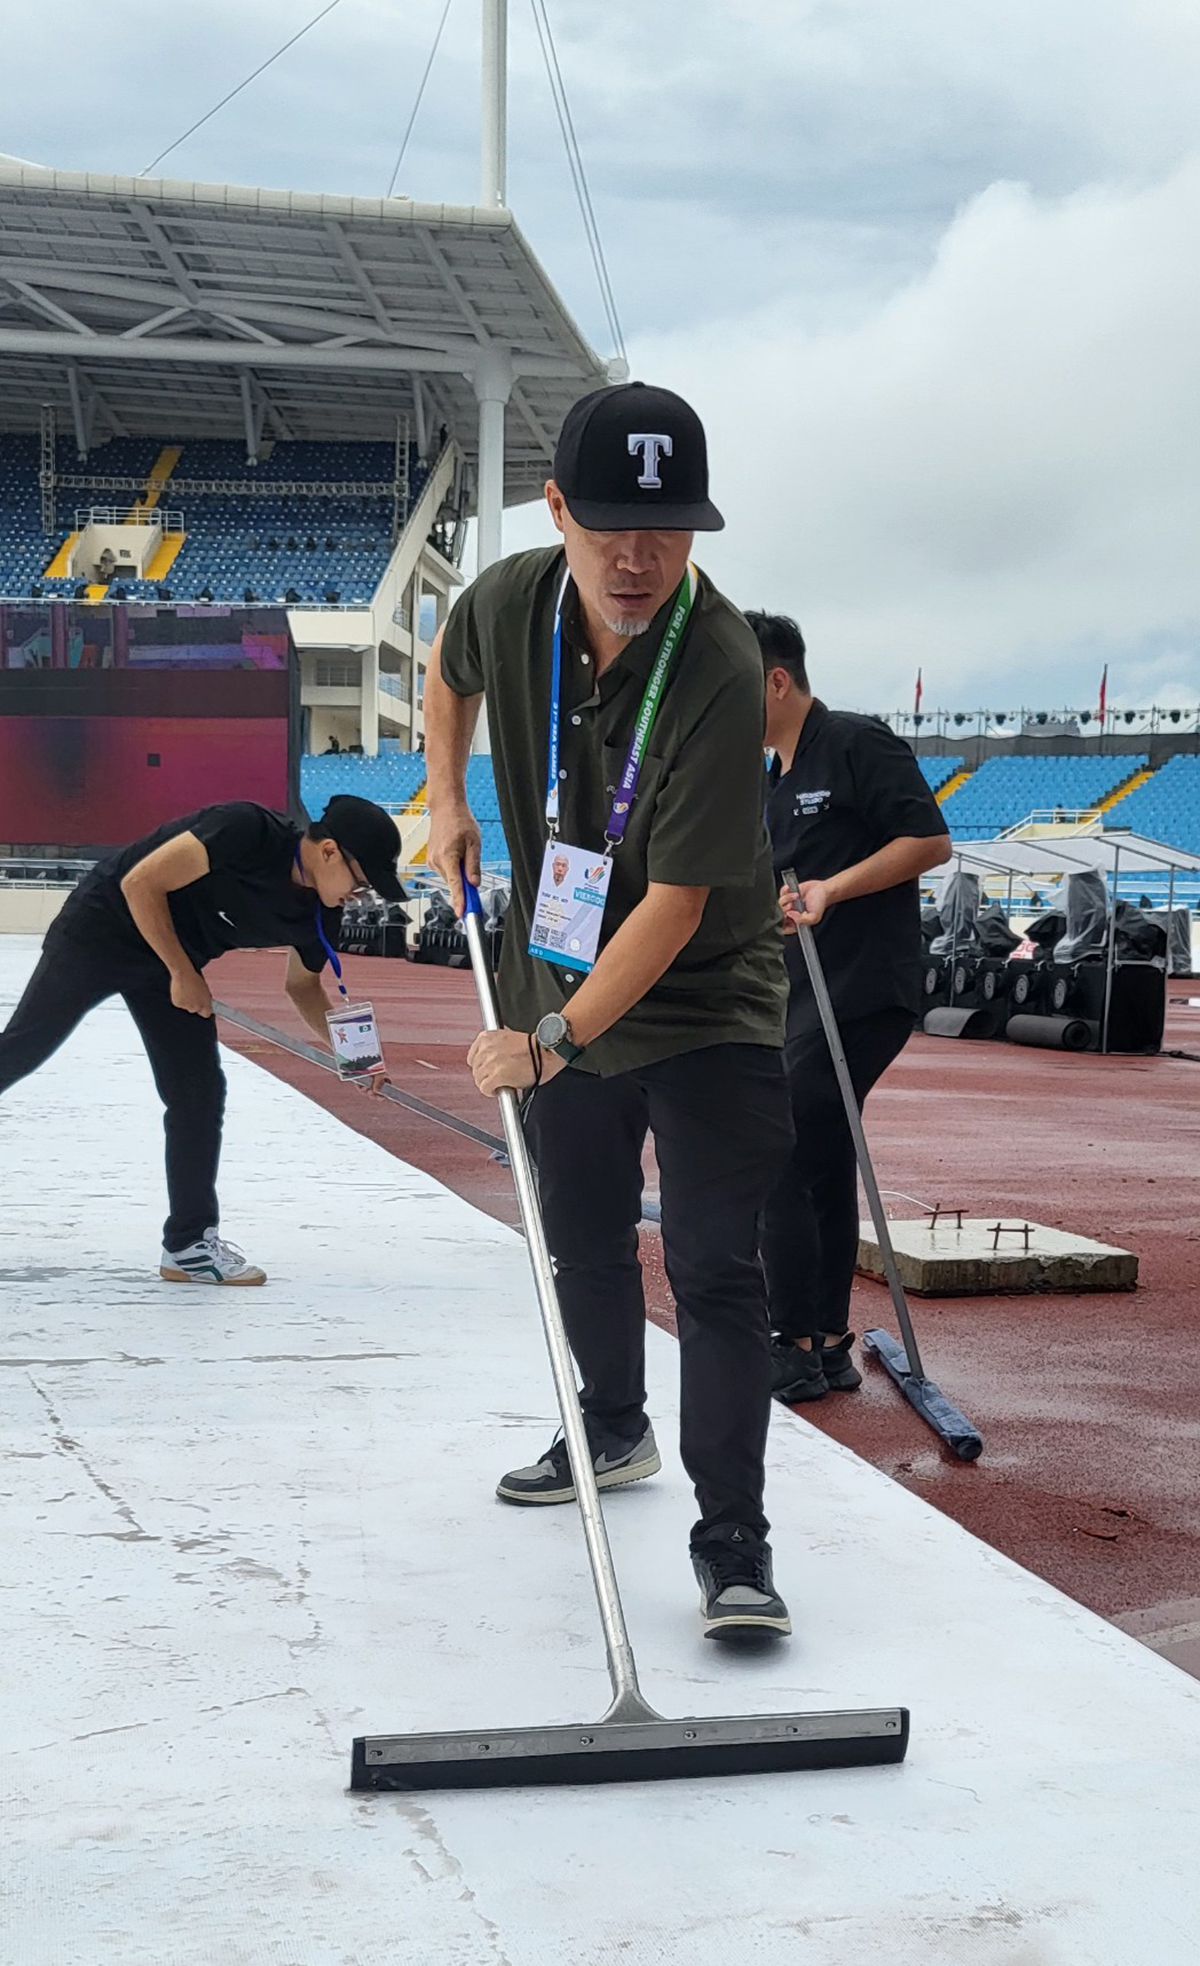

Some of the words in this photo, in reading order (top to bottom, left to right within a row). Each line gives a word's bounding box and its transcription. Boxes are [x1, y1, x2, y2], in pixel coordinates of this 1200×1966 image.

[628, 434, 672, 489] T
[669, 630, 677, 639] A
[672, 605, 686, 628] FOR
[648, 639, 674, 699] STRONGER
[629, 701, 655, 766] SOUTHEAST
[622, 766, 636, 790] ASIA
